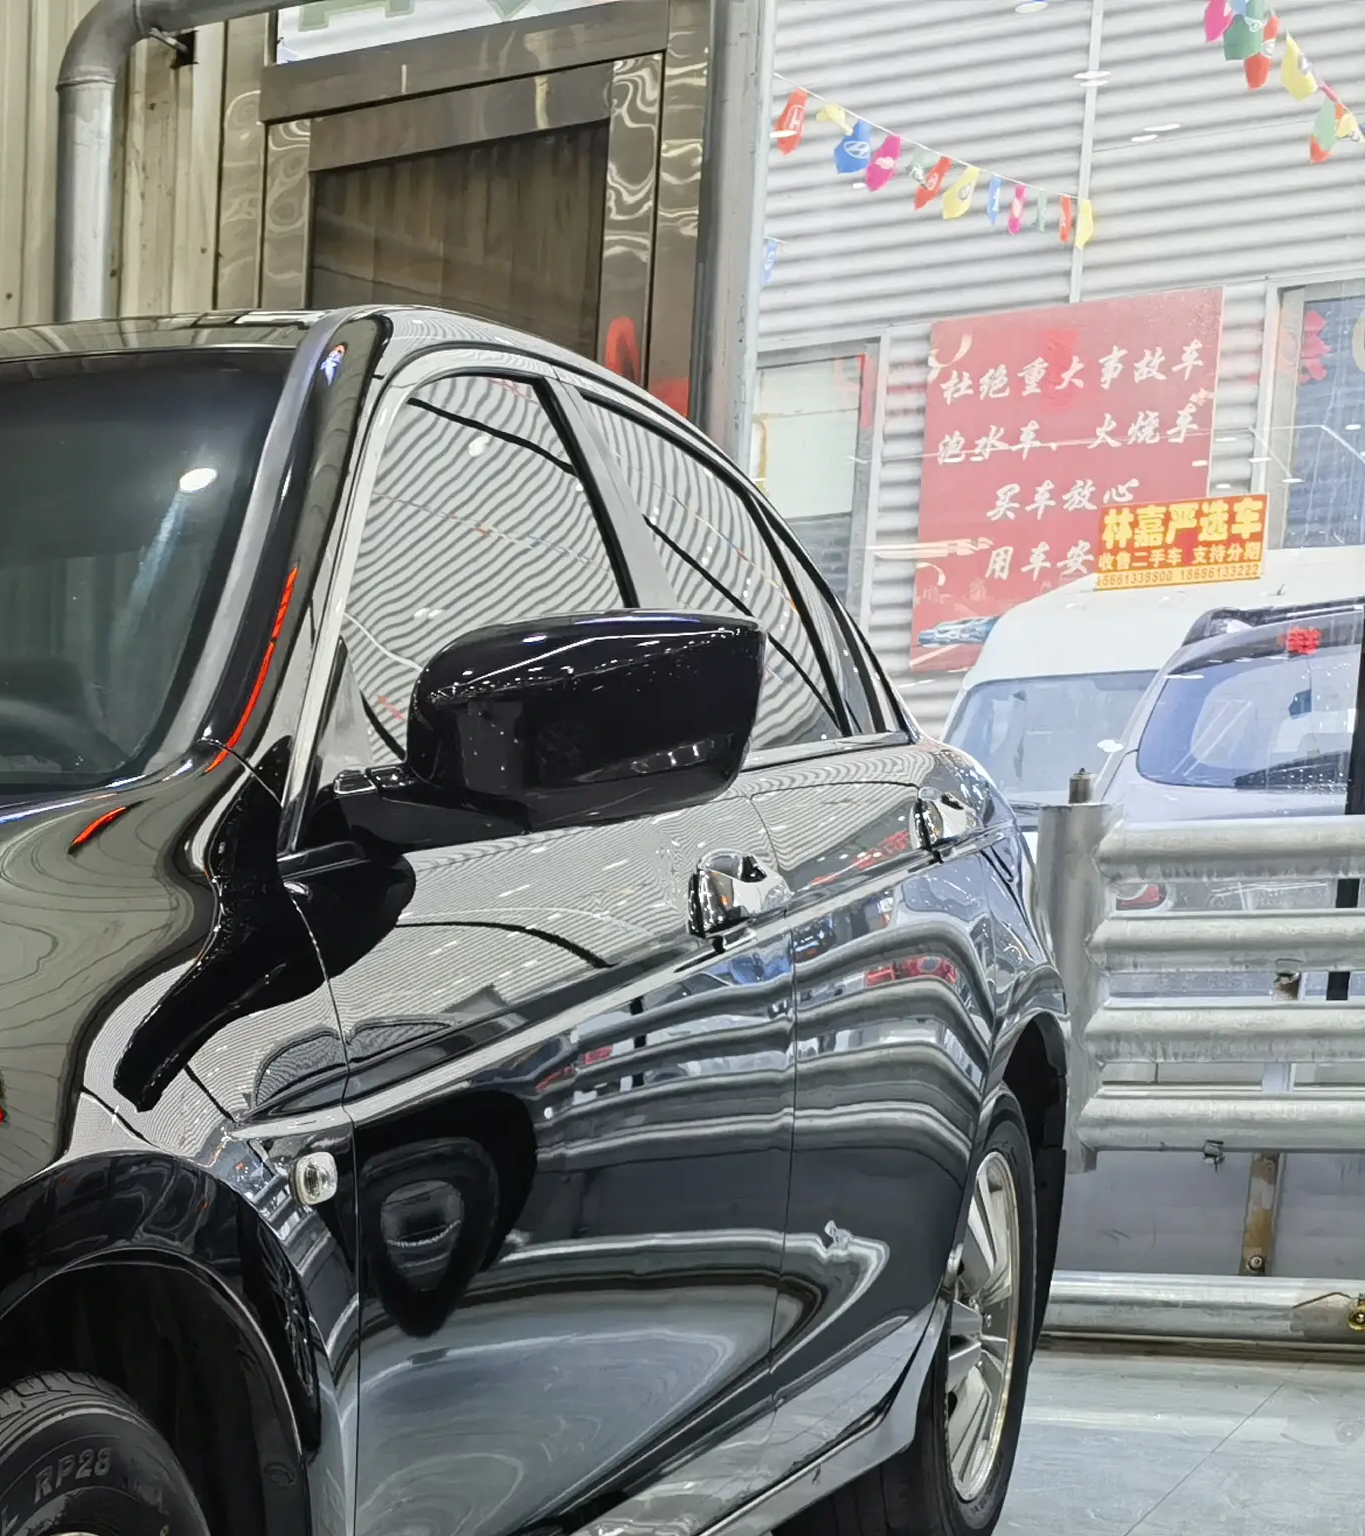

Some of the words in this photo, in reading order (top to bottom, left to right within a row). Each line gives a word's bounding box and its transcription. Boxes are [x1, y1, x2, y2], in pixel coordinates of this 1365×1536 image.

[939, 338, 1204, 405] 杜绝重大事故车
[986, 478, 1140, 521] 买车放心
[1102, 497, 1263, 550] 林嘉严选车
[1097, 547, 1183, 571] 收售二手车
[1192, 541, 1261, 565] 支持分期
[33, 1446, 112, 1506] RP28
